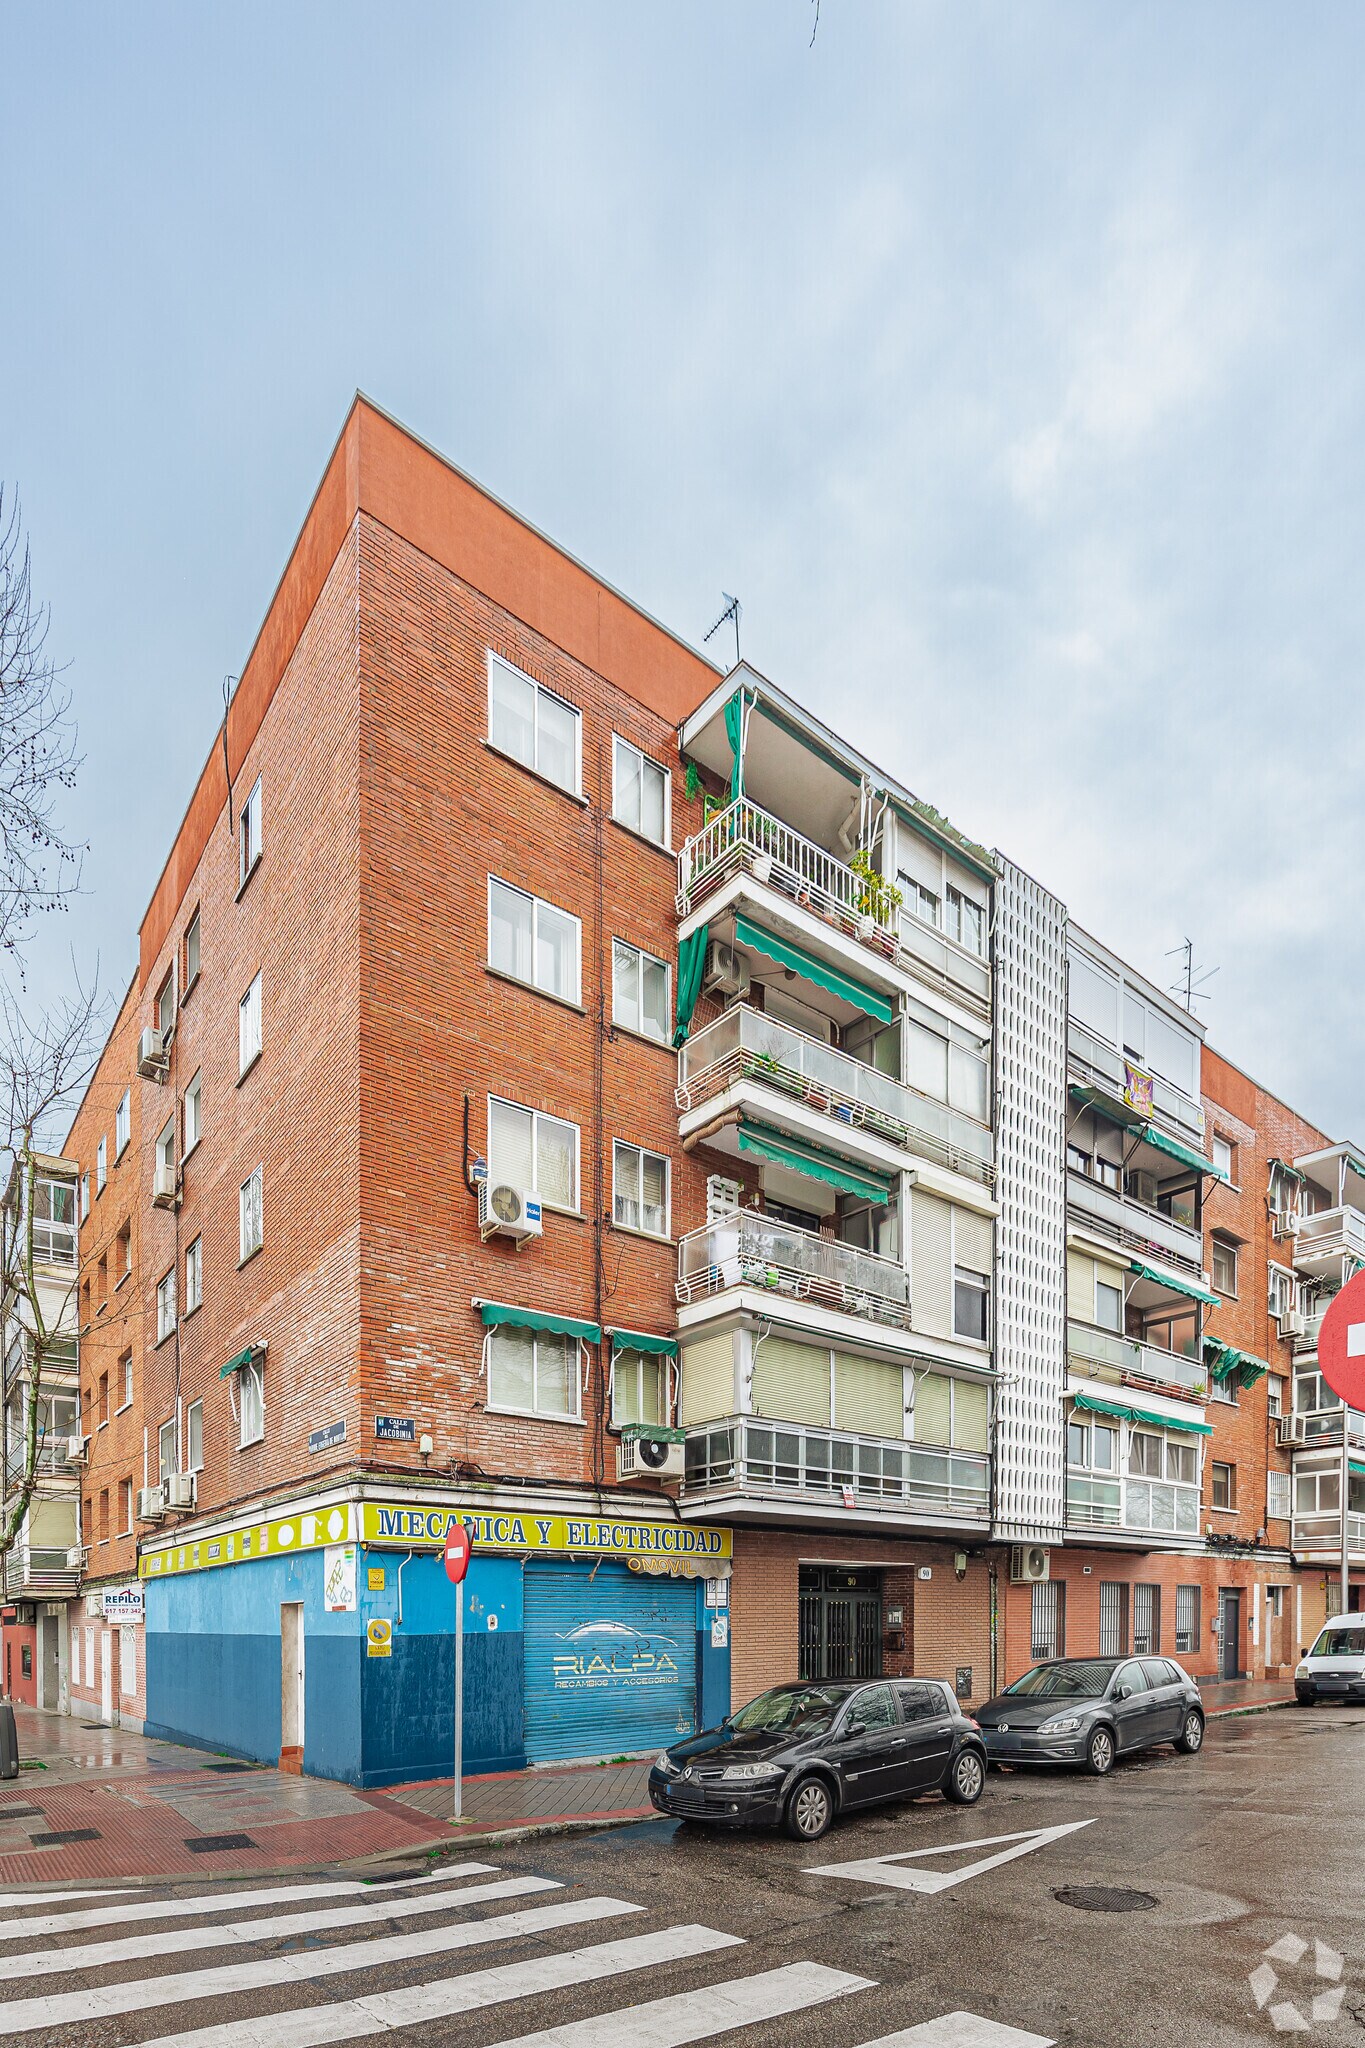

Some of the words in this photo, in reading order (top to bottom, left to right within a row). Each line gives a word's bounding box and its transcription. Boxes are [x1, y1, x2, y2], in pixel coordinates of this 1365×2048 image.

[527, 1208, 540, 1216] Haier
[389, 1418, 408, 1426] CALLE
[379, 1428, 411, 1439] JACOBINIA
[536, 1521, 552, 1544] Y
[567, 1521, 722, 1553] ELECTRICIDAD
[627, 1557, 697, 1575] OMOVIL
[922, 1569, 930, 1578] 90
[847, 1577, 856, 1586] 90
[105, 1591, 141, 1603] REPILO
[553, 1653, 678, 1676] RIALPA
[554, 1679, 609, 1688] RECAMBIOS
[622, 1676, 679, 1685] ACCESORIOS
